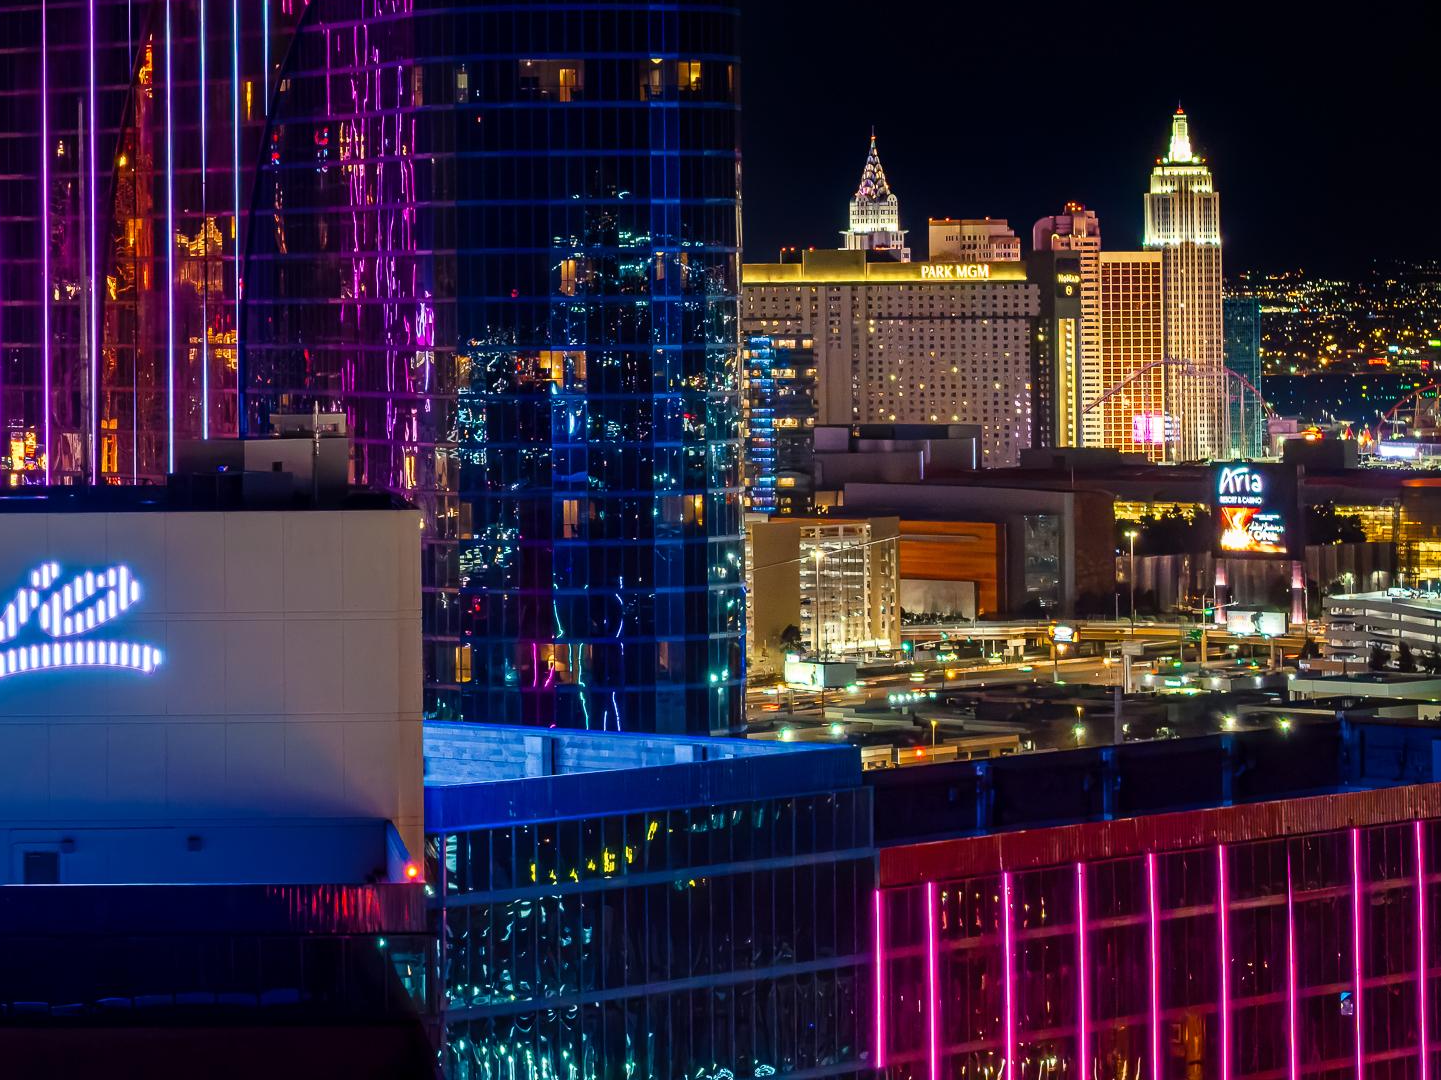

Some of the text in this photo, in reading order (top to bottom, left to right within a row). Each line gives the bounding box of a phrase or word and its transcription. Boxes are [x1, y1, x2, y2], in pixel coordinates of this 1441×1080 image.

[921, 264, 990, 279] PARK MGM
[1219, 467, 1263, 494] Aria
